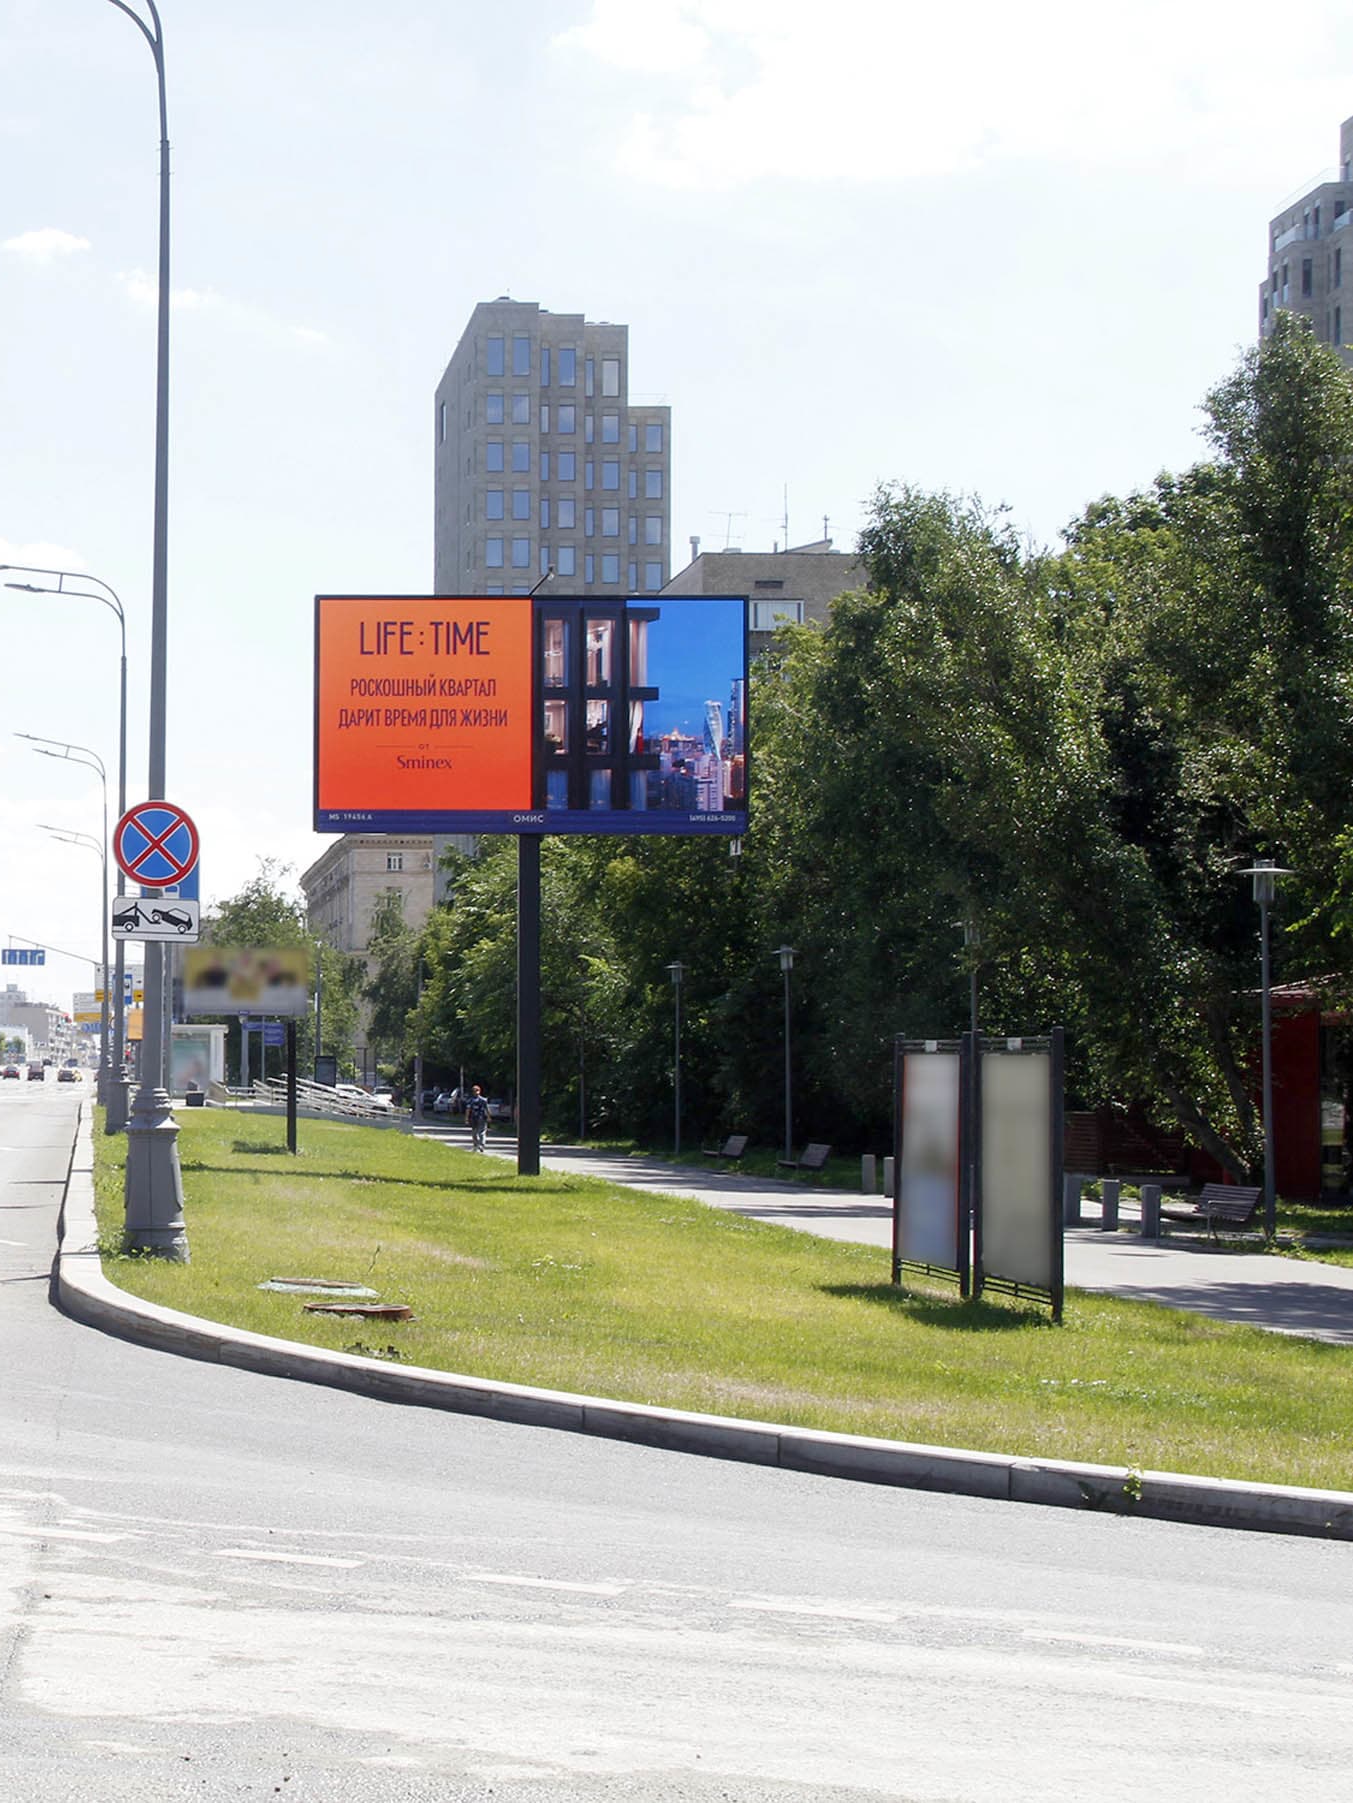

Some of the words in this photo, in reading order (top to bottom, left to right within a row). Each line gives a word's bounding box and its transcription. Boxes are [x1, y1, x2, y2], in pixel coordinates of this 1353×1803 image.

[350, 673, 436, 697] РОСКОШНЫЙ
[439, 678, 496, 697] КВАРТАЛ
[338, 708, 381, 729] ДАРИТ
[384, 708, 427, 727] ВРЕМЯ
[429, 708, 457, 729] ДЛЯ
[460, 708, 508, 727] ЖИЗНИ
[396, 754, 453, 769] Sminex
[513, 814, 544, 823] ОМИС
